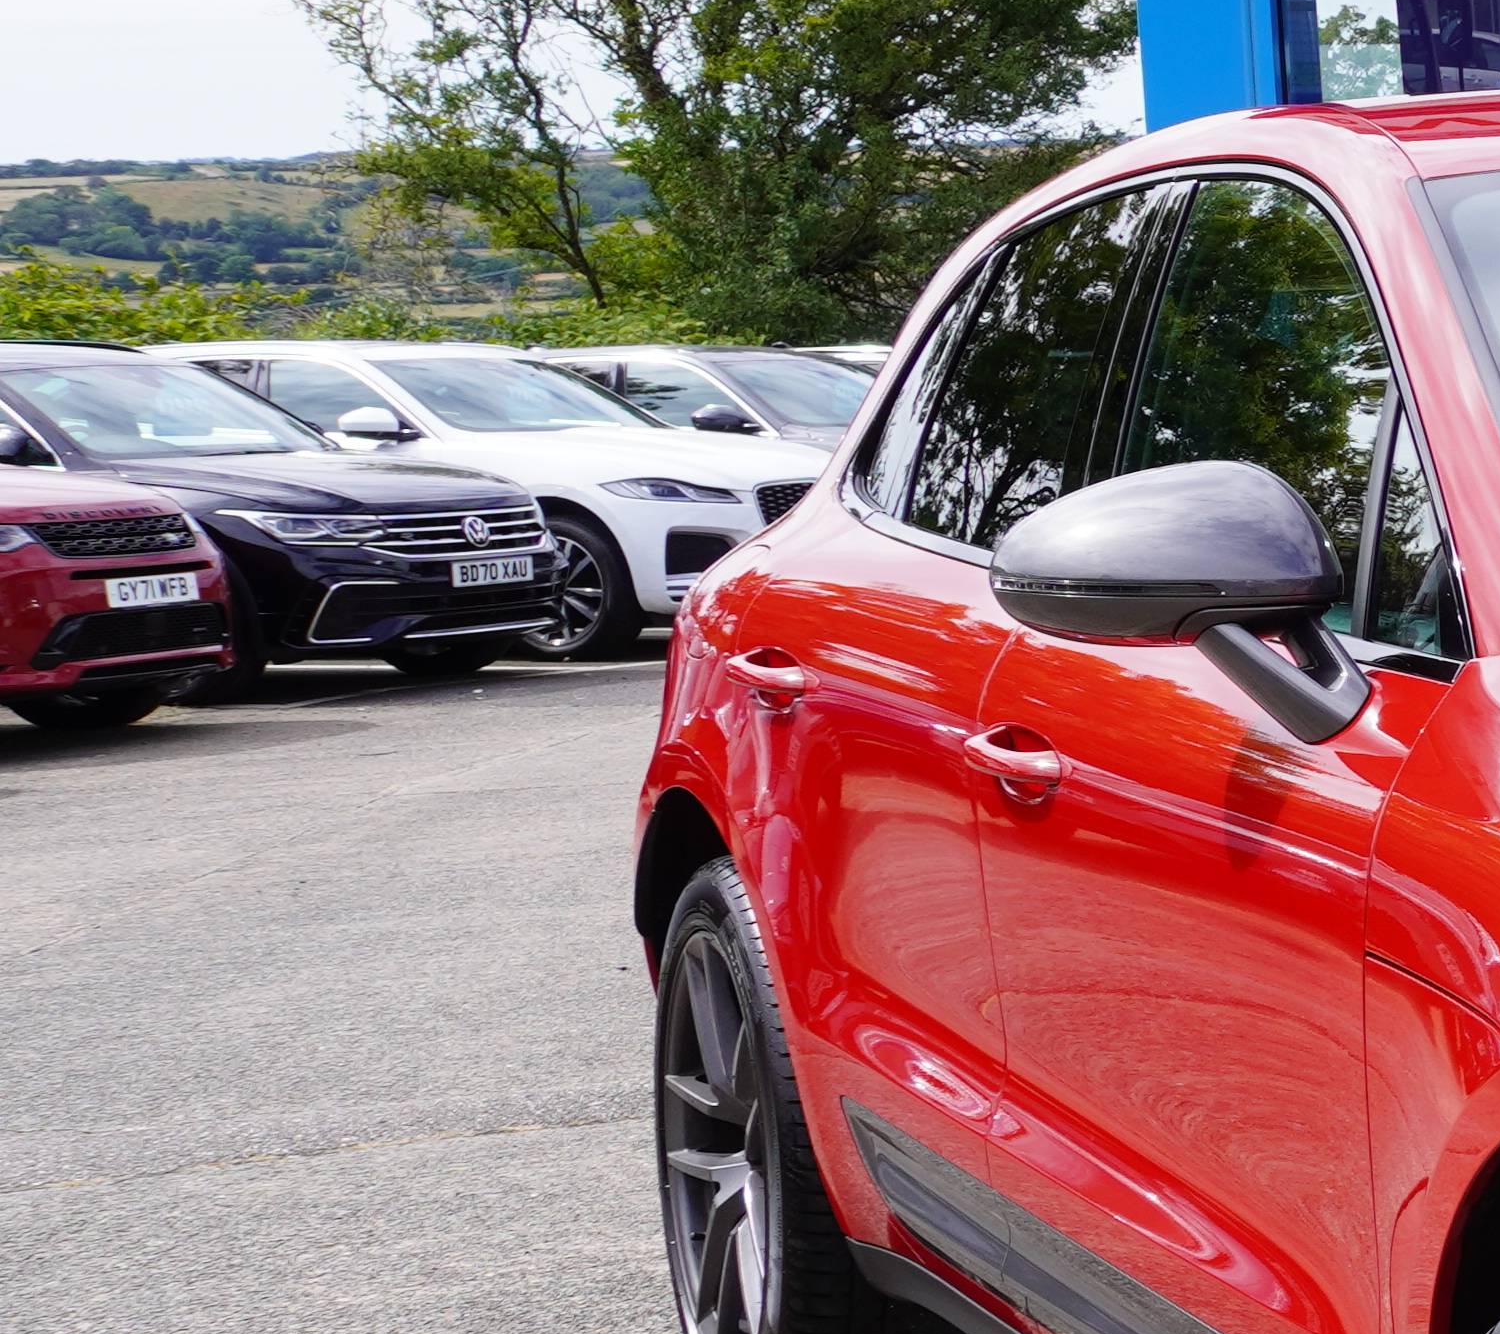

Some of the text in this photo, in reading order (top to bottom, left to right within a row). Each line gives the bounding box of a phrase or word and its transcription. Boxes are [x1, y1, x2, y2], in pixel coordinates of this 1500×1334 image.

[460, 560, 528, 583] BD70 XAU
[117, 576, 188, 602] GY71 WFB
